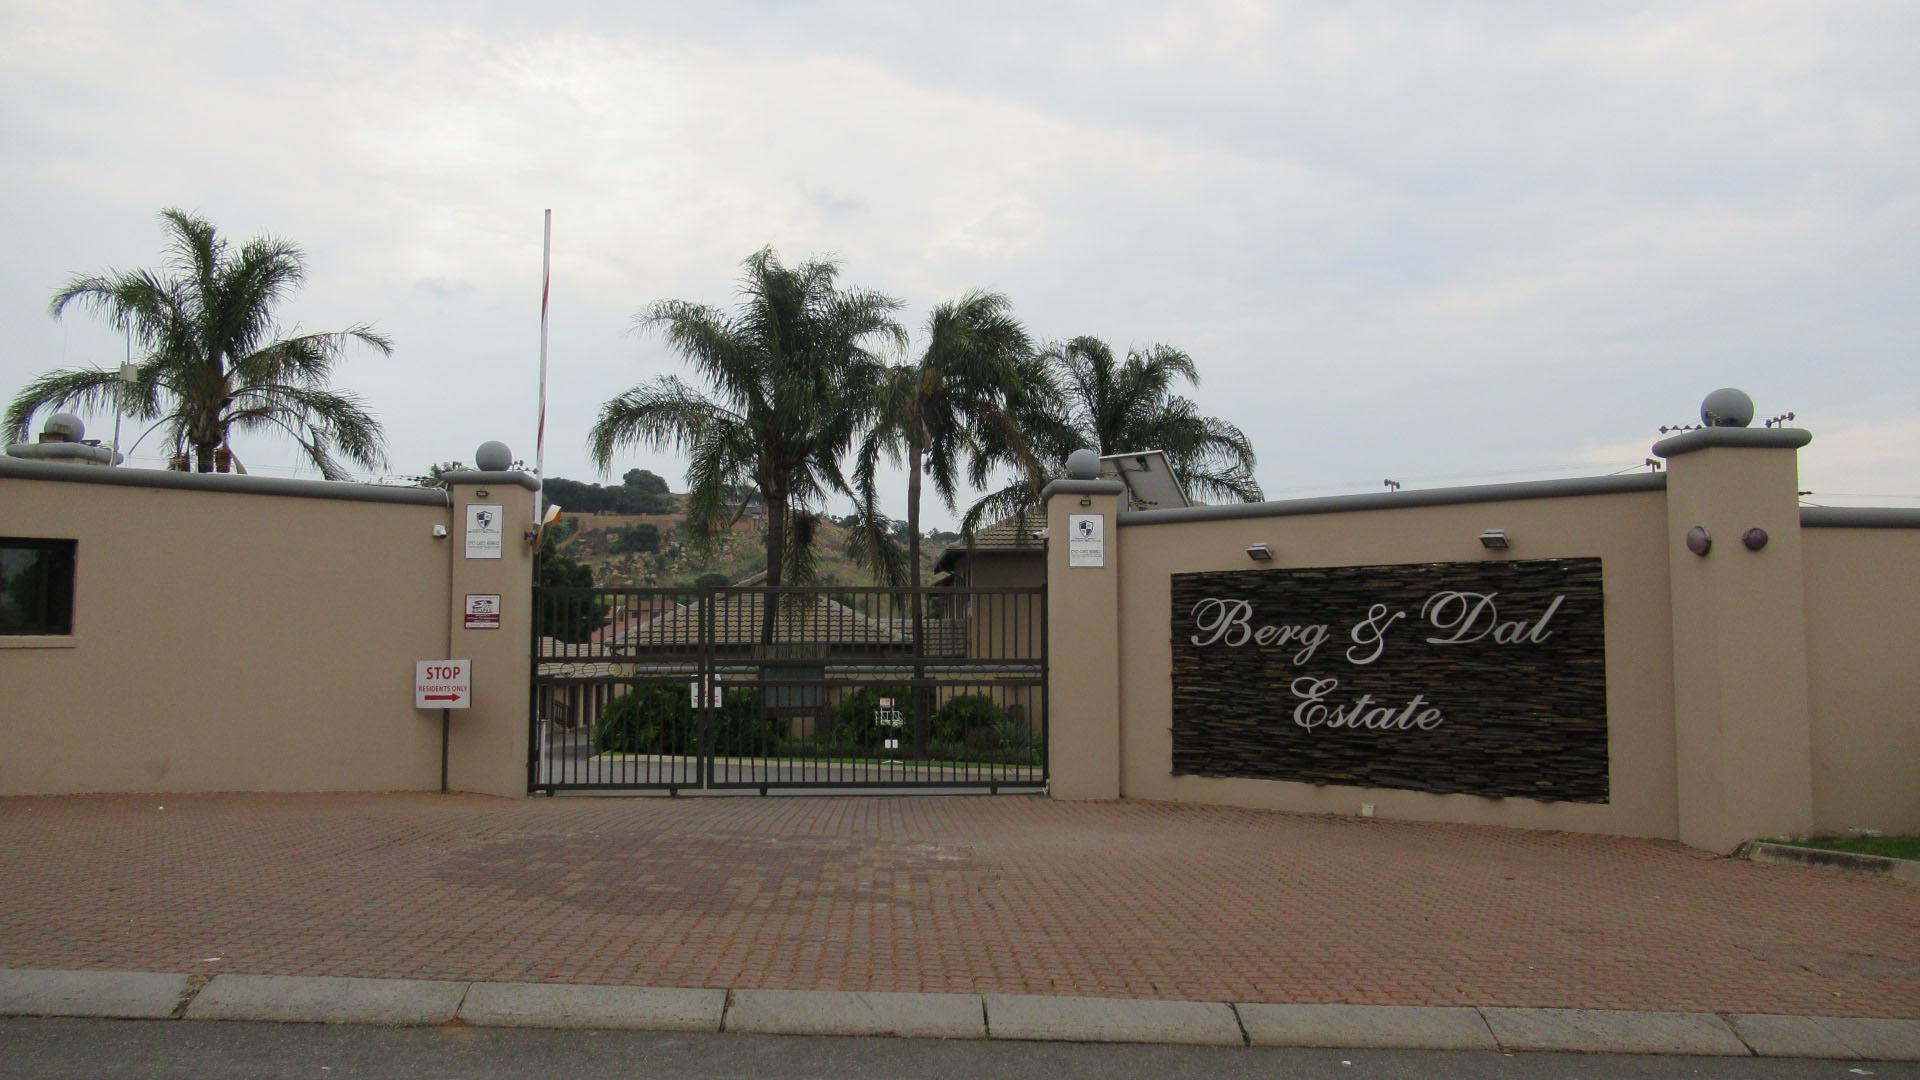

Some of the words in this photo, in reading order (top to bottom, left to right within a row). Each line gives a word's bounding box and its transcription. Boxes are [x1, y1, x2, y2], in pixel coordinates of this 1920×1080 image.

[1190, 597, 1330, 666] Berg
[1346, 603, 1406, 665] &
[1420, 590, 1566, 645] Dal
[426, 666, 461, 680] STOP
[1290, 676, 1444, 734] Estate
